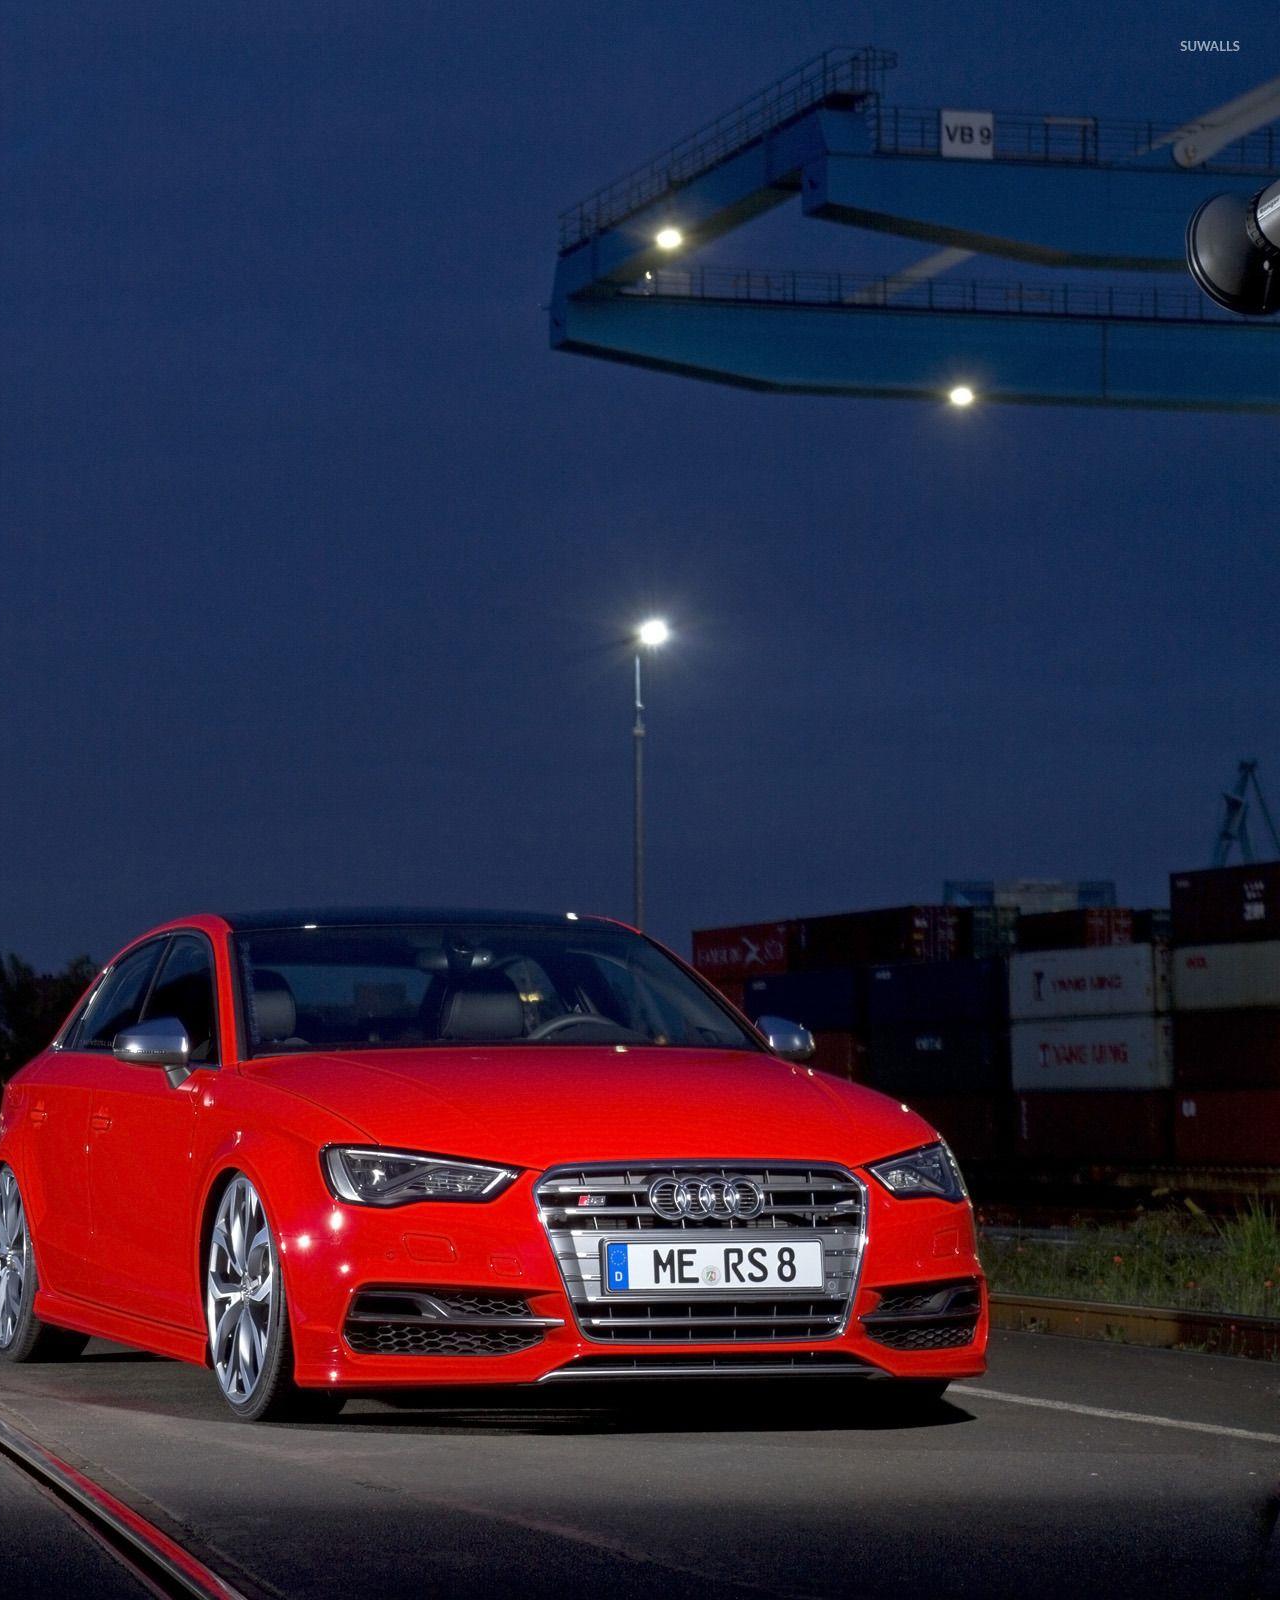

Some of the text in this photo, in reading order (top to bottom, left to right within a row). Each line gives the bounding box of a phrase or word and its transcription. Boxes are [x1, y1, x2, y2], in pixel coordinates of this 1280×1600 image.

[944, 124, 992, 145] VB 9
[653, 1246, 797, 1284] ME RS 8
[614, 1271, 623, 1282] D
